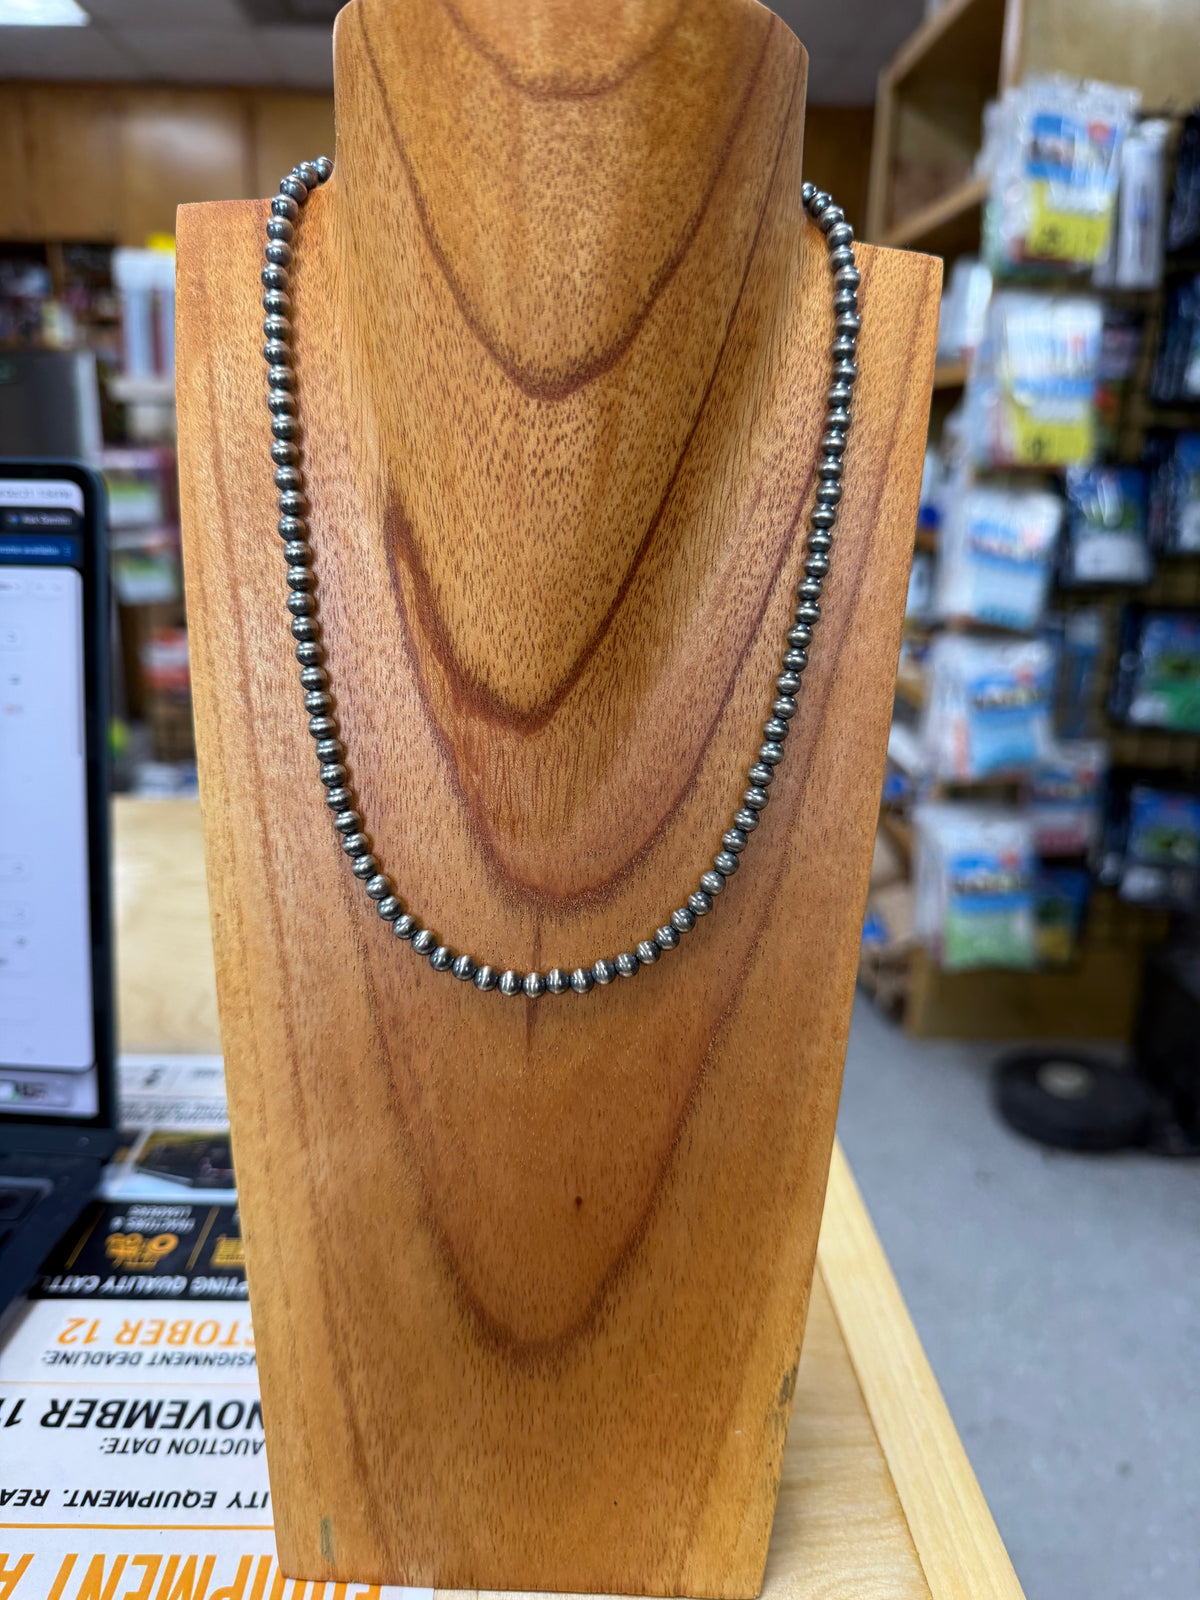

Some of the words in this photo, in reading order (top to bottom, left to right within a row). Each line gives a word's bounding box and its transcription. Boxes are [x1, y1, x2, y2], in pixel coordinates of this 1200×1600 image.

[42, 1274, 101, 1295] CATT
[99, 1275, 188, 1297] QUALITY
[57, 1318, 101, 1345] 12
[41, 1350, 143, 1366] DEADLINE:
[40, 1400, 264, 1430] NOVEMBER
[99, 1437, 161, 1455] DATE:
[167, 1438, 265, 1455] AUCTION
[63, 1489, 218, 1508] EQUIPMENT.
